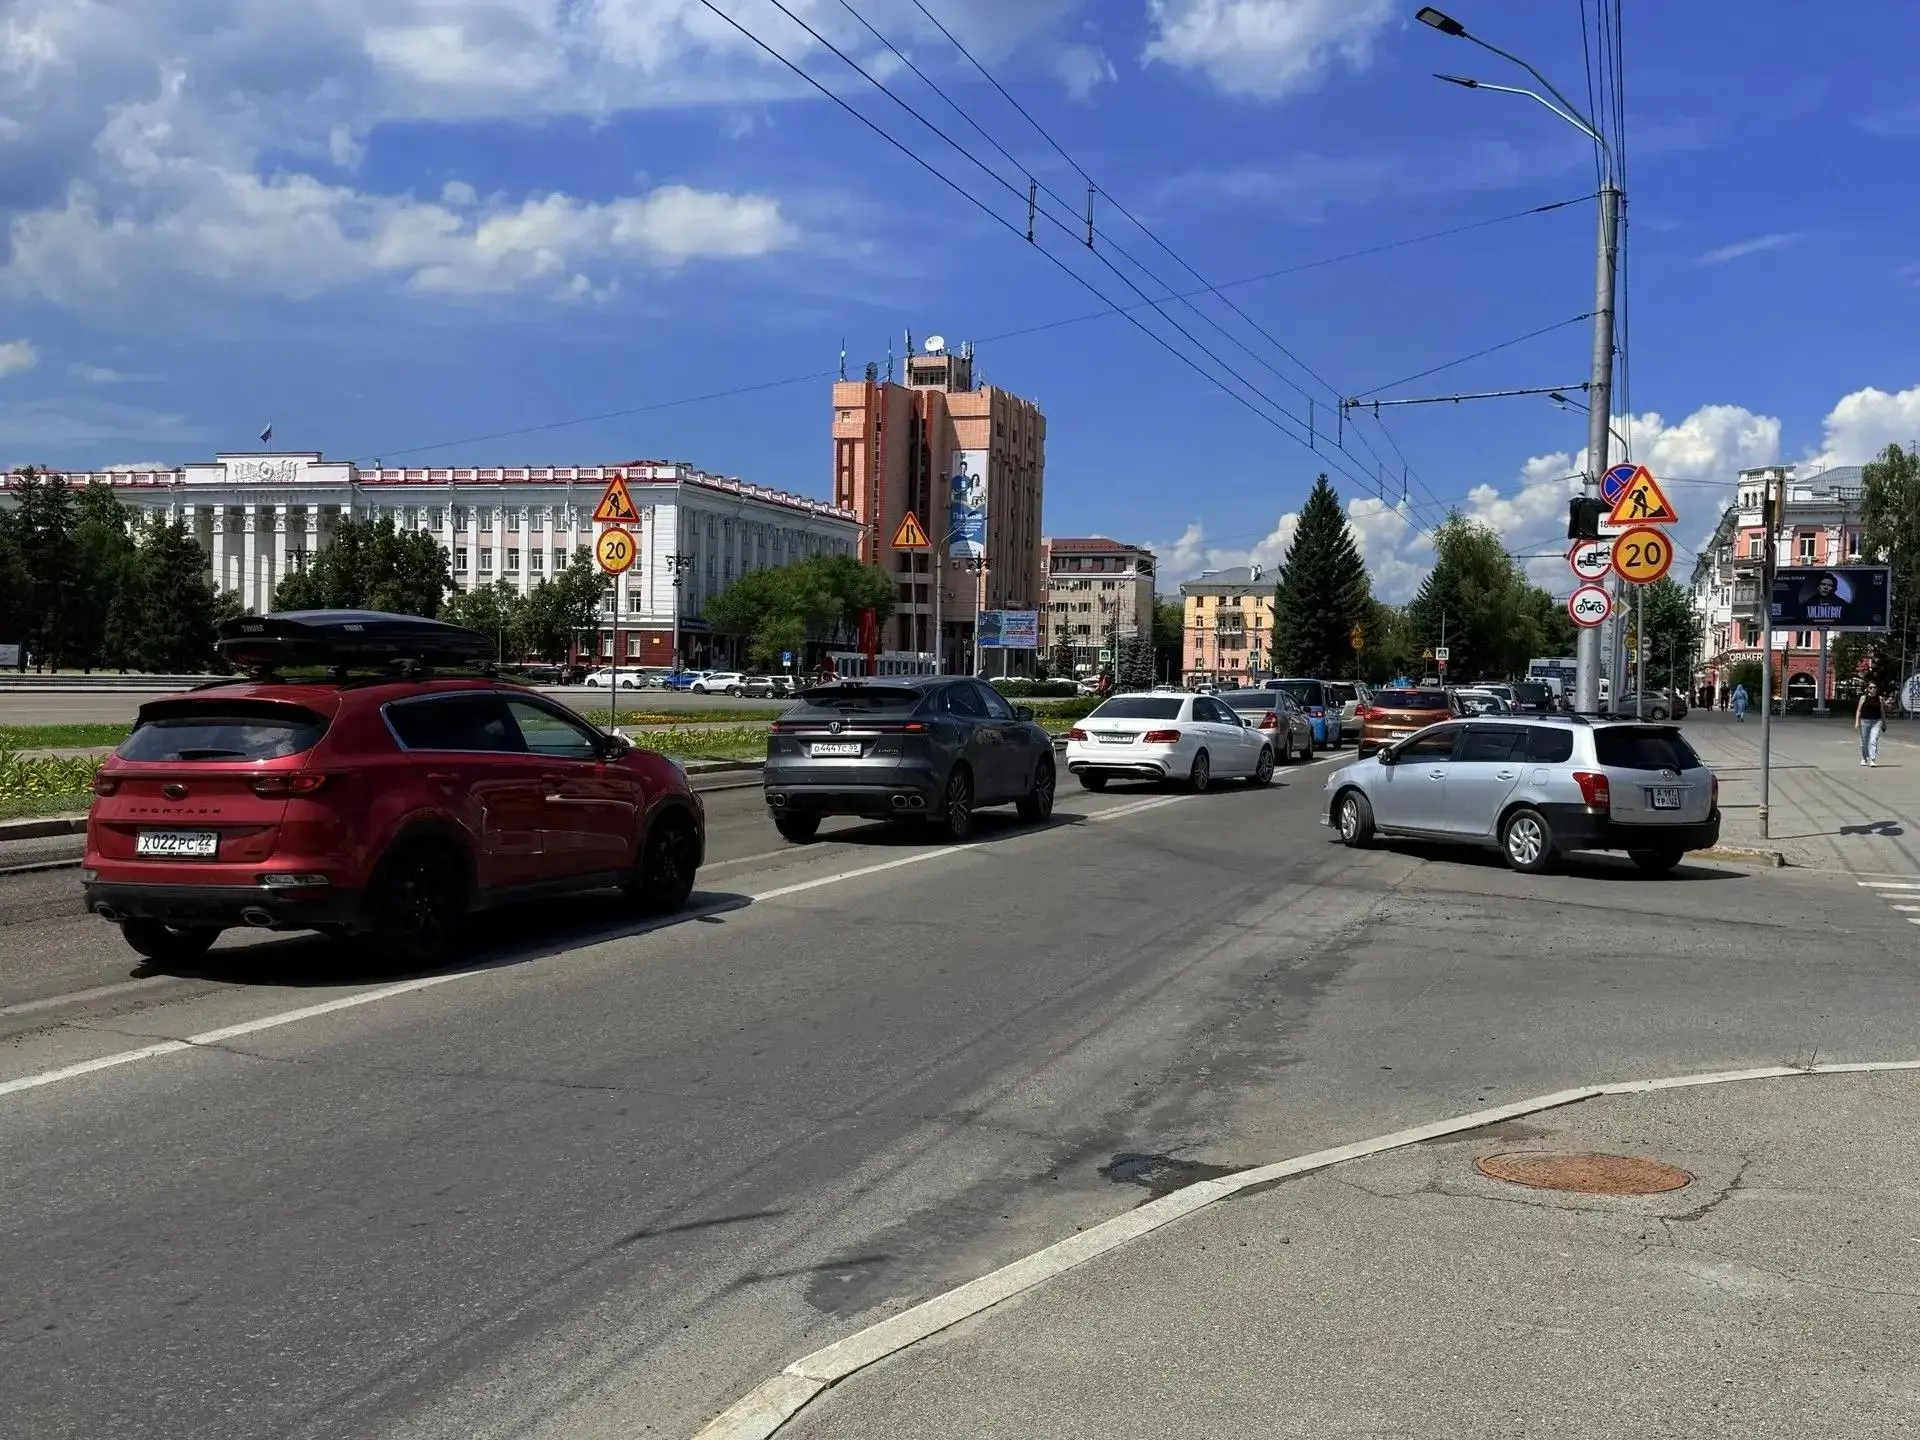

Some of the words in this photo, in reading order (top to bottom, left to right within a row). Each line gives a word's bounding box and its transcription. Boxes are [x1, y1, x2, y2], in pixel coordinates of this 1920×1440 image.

[606, 541, 626, 560] 20
[1624, 541, 1662, 568] 20
[1729, 652, 1765, 662] OBAKER
[198, 834, 212, 847] 22
